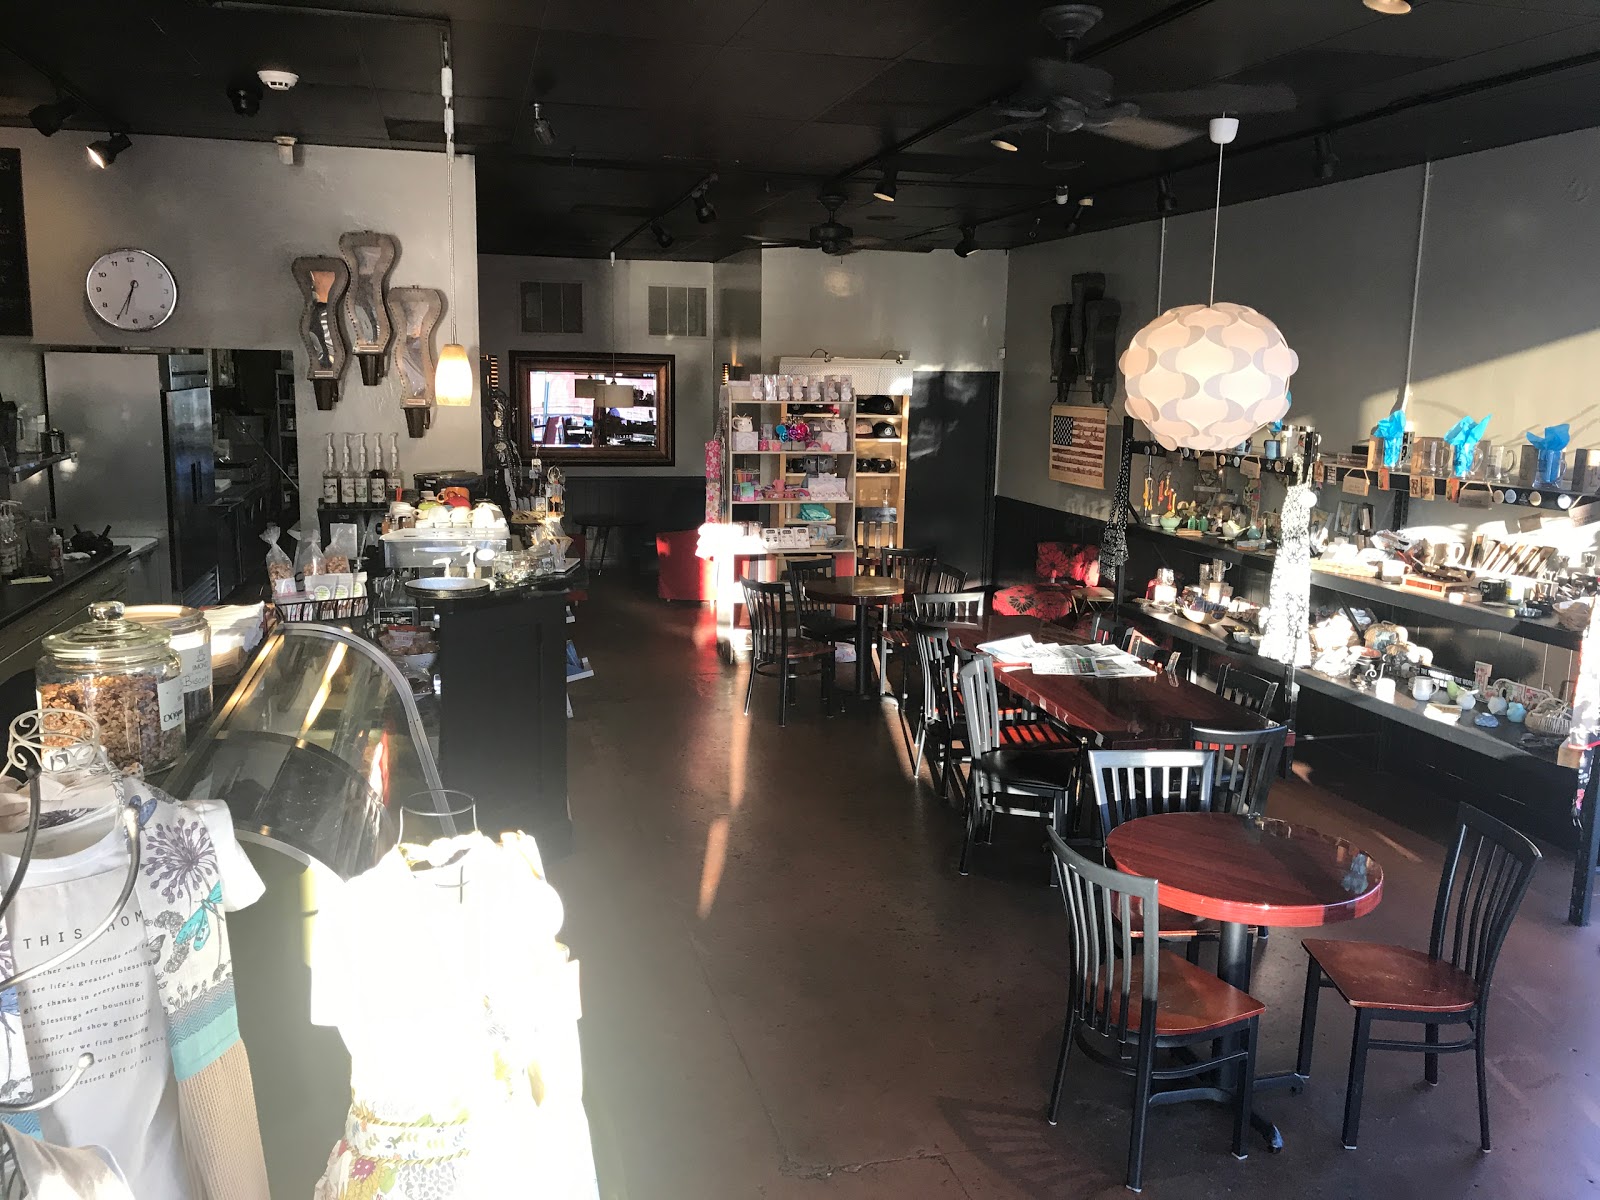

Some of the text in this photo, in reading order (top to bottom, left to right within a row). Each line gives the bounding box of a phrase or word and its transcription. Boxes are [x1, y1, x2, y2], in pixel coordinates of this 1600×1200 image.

[23, 928, 83, 949] THIS
[66, 961, 86, 970] with
[90, 954, 122, 966] friends
[124, 946, 138, 956] and
[23, 1004, 43, 1015] give
[47, 997, 77, 1007] thanks
[93, 980, 144, 998] everything.
[32, 986, 46, 994] are
[50, 980, 74, 990] life's
[78, 972, 114, 987] greatest
[34, 1034, 65, 1044] simply
[68, 1026, 83, 1036] and
[86, 1022, 109, 1031] show
[113, 1008, 152, 1028] gratitude
[40, 1013, 82, 1026] blessings
[85, 1007, 98, 1015] are
[102, 995, 145, 1010] bountiful
[29, 1046, 75, 1061] simplicity
[95, 1037, 113, 1047] find
[117, 1025, 149, 1041] meaning
[97, 1054, 117, 1063] with
[120, 1047, 137, 1057] full
[50, 1084, 63, 1092] th
[72, 1073, 105, 1089] reatest
[109, 1067, 126, 1079] gift
[140, 1055, 152, 1064] all
